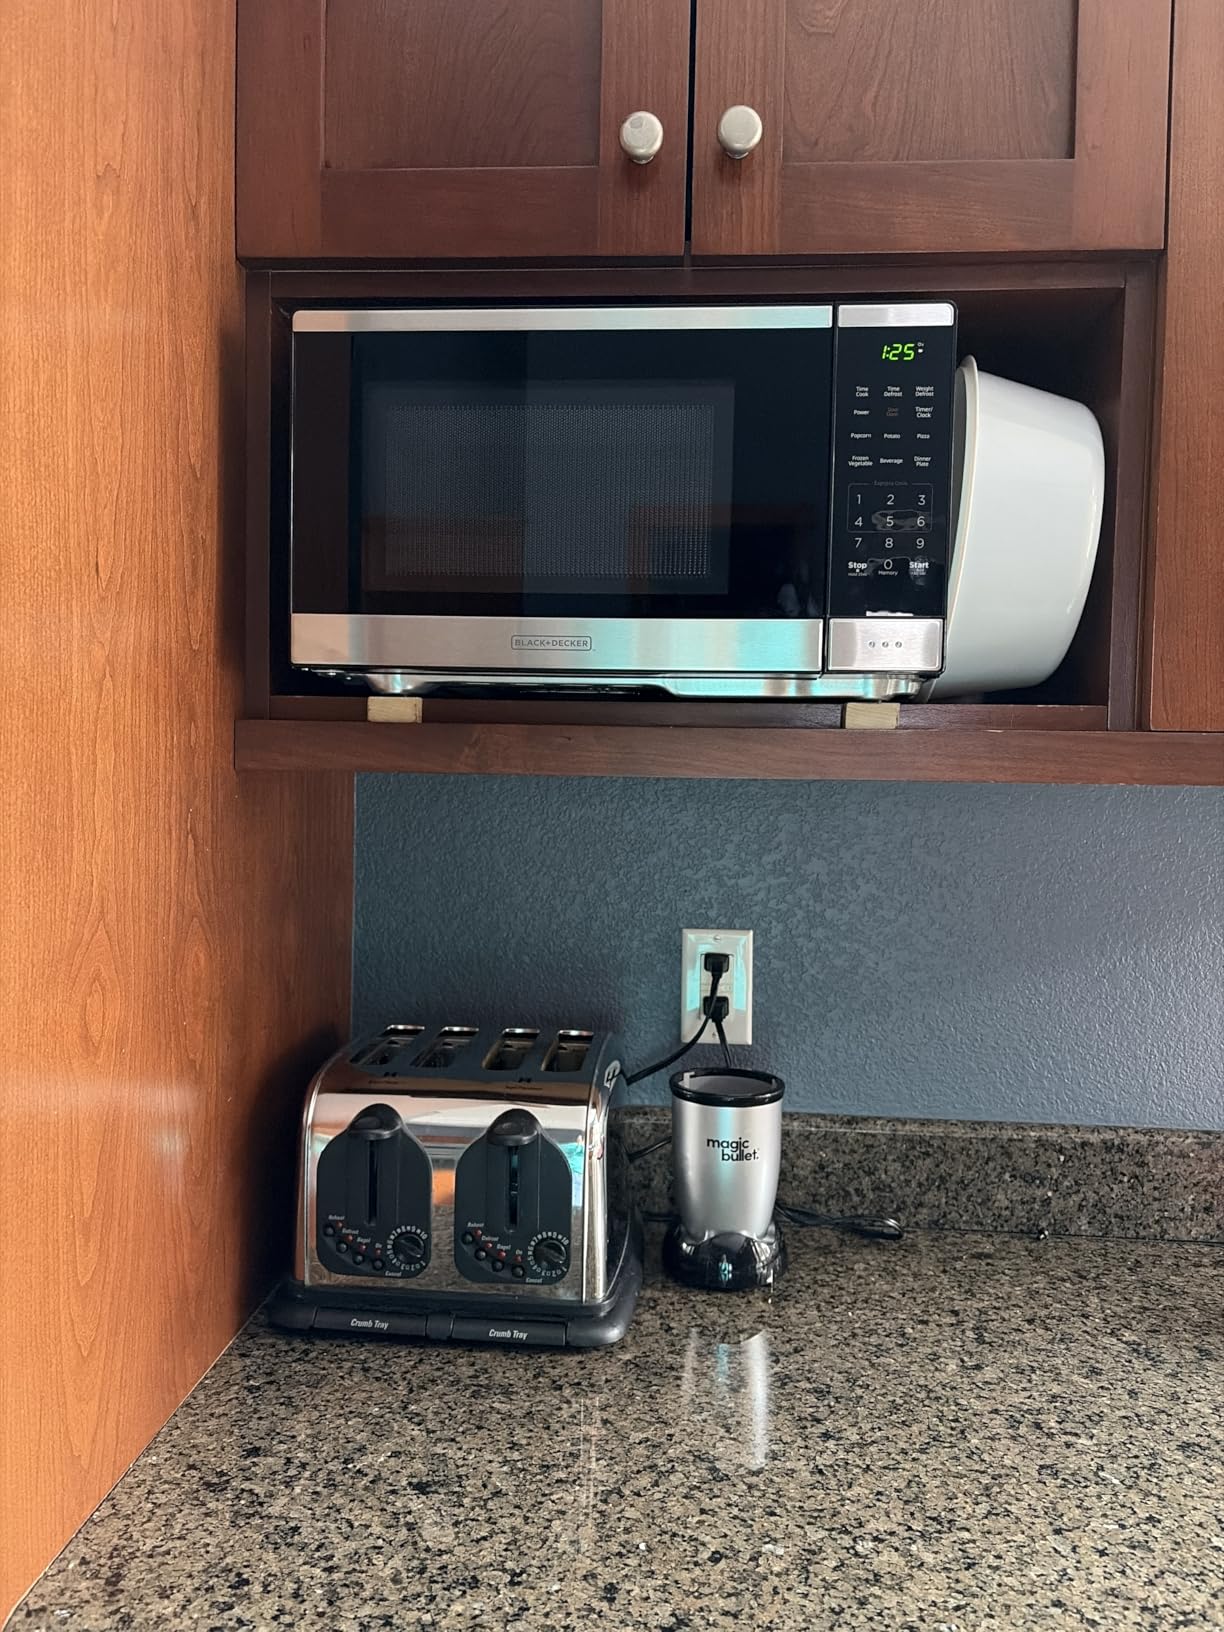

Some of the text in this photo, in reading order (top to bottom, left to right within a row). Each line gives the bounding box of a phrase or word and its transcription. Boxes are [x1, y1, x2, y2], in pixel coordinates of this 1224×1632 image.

[882, 344, 915, 360] 1:25
[857, 494, 861, 504] 1
[887, 494, 894, 505] 2
[918, 495, 926, 505] 3
[854, 516, 863, 527] 4
[886, 516, 894, 526] 5
[917, 516, 925, 527] 6
[854, 538, 862, 548] 7
[885, 538, 894, 548] 8
[916, 538, 924, 548] 9
[884, 559, 892, 570] 0
[707, 1137, 749, 1152] magic
[350, 1318, 389, 1330] Crumb Tray
[489, 1329, 528, 1340] Crumb Tray
